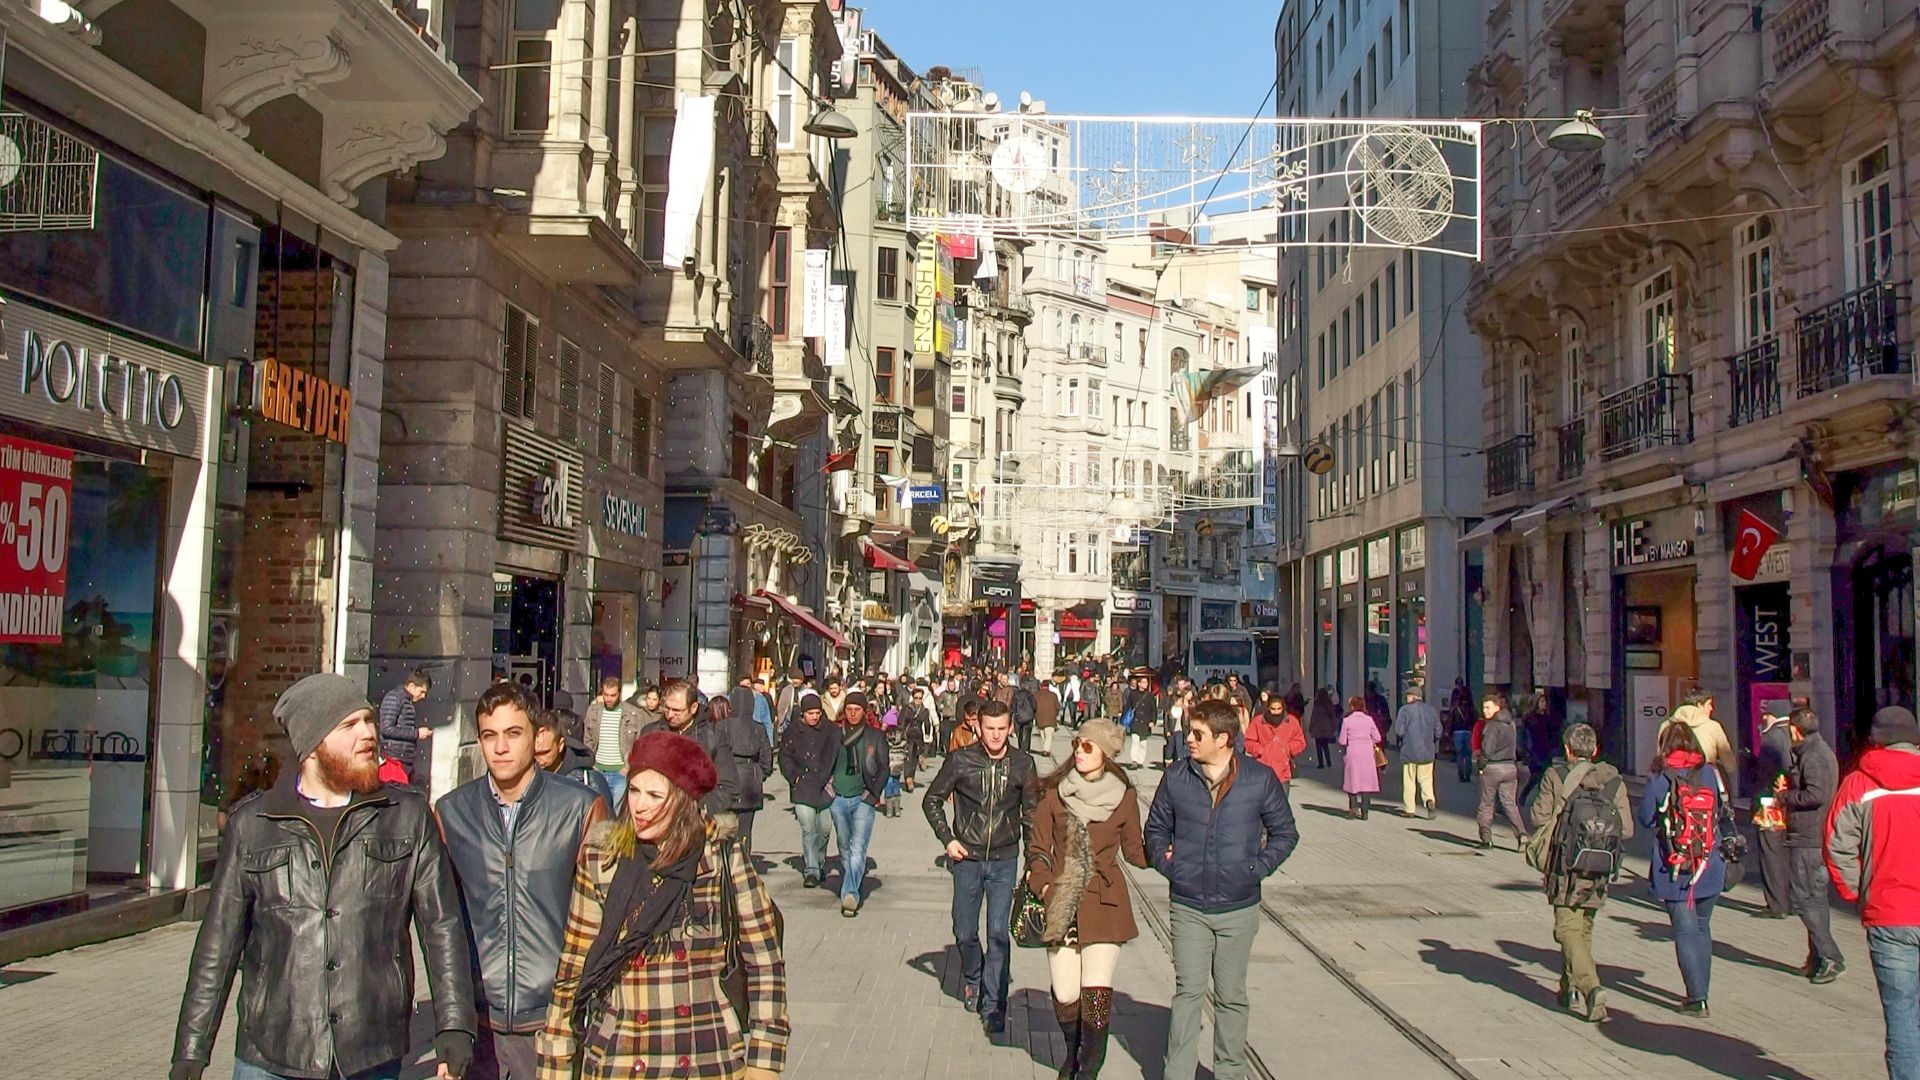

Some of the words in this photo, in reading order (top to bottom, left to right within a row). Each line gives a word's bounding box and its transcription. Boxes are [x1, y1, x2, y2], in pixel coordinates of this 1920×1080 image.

[914, 270, 933, 354] ENGLISH
[21, 328, 185, 432] POLETTO
[261, 357, 352, 444] GREYDER
[0, 445, 22, 470] TÜM
[22, 447, 73, 480] ÜRÜNLERDE
[899, 489, 940, 499] RKCELL
[0, 481, 68, 573] %50
[1649, 545, 1660, 561] BY
[1660, 539, 1688, 559] MANGO
[1755, 605, 1779, 675] WEST
[1643, 706, 1667, 717] 50
